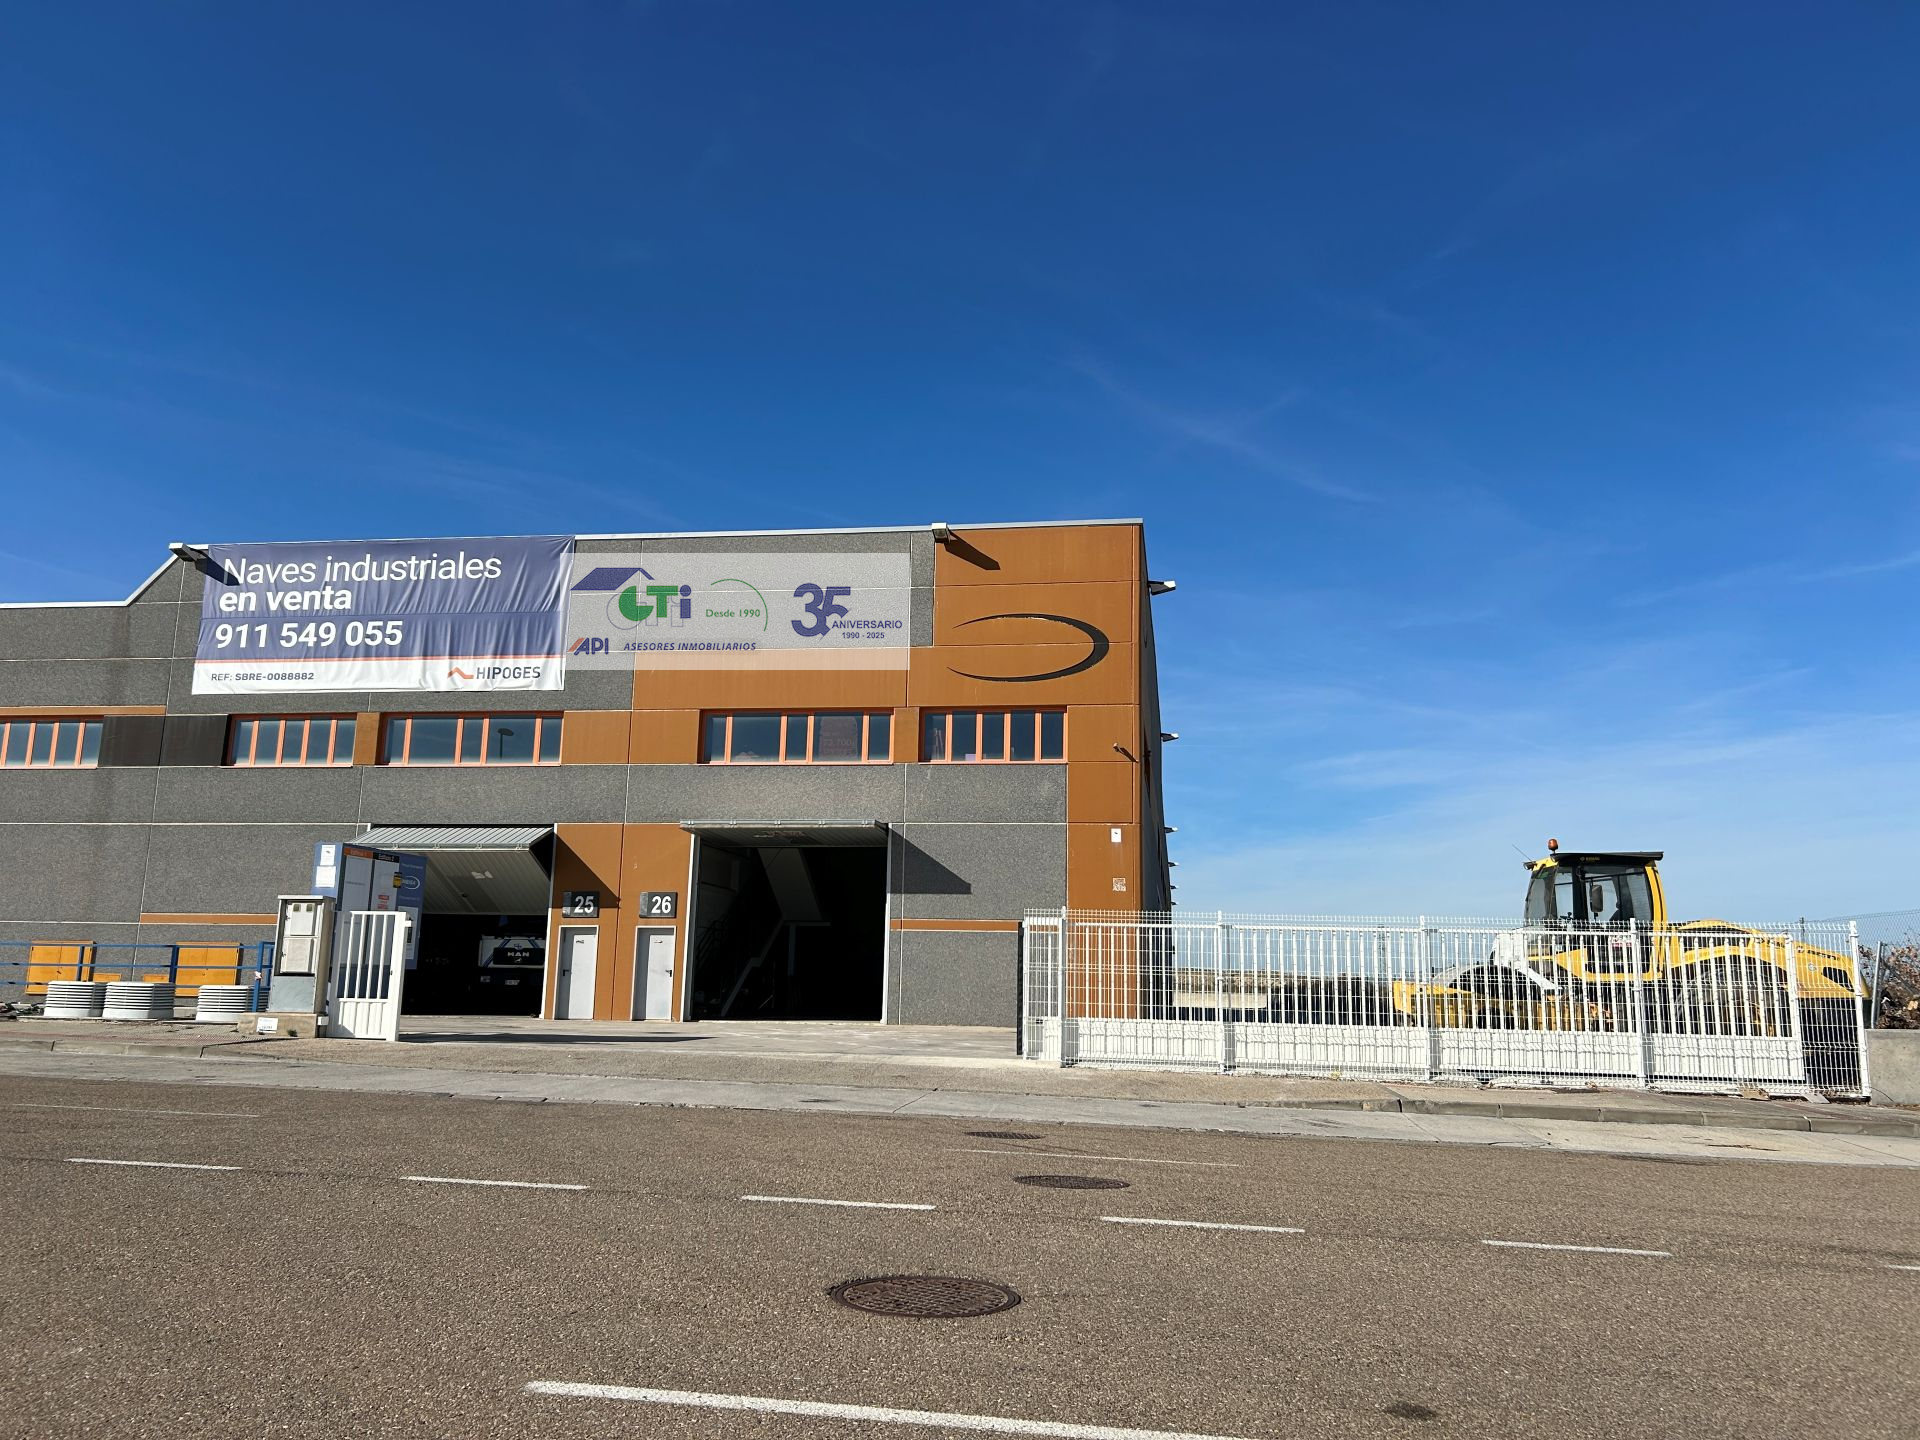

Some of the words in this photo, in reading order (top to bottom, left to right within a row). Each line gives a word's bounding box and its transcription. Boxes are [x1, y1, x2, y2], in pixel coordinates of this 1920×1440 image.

[223, 558, 317, 585] Naves
[324, 551, 502, 582] industriales
[219, 590, 257, 612] en
[266, 585, 353, 611] venta
[214, 623, 268, 649] 911
[279, 621, 337, 647] 549
[344, 620, 403, 647] 055
[211, 673, 233, 681] REF:
[235, 672, 315, 681] SBRE-0088882
[476, 666, 541, 680] HIPOGES
[573, 895, 595, 914] 25
[651, 895, 672, 914] 26
